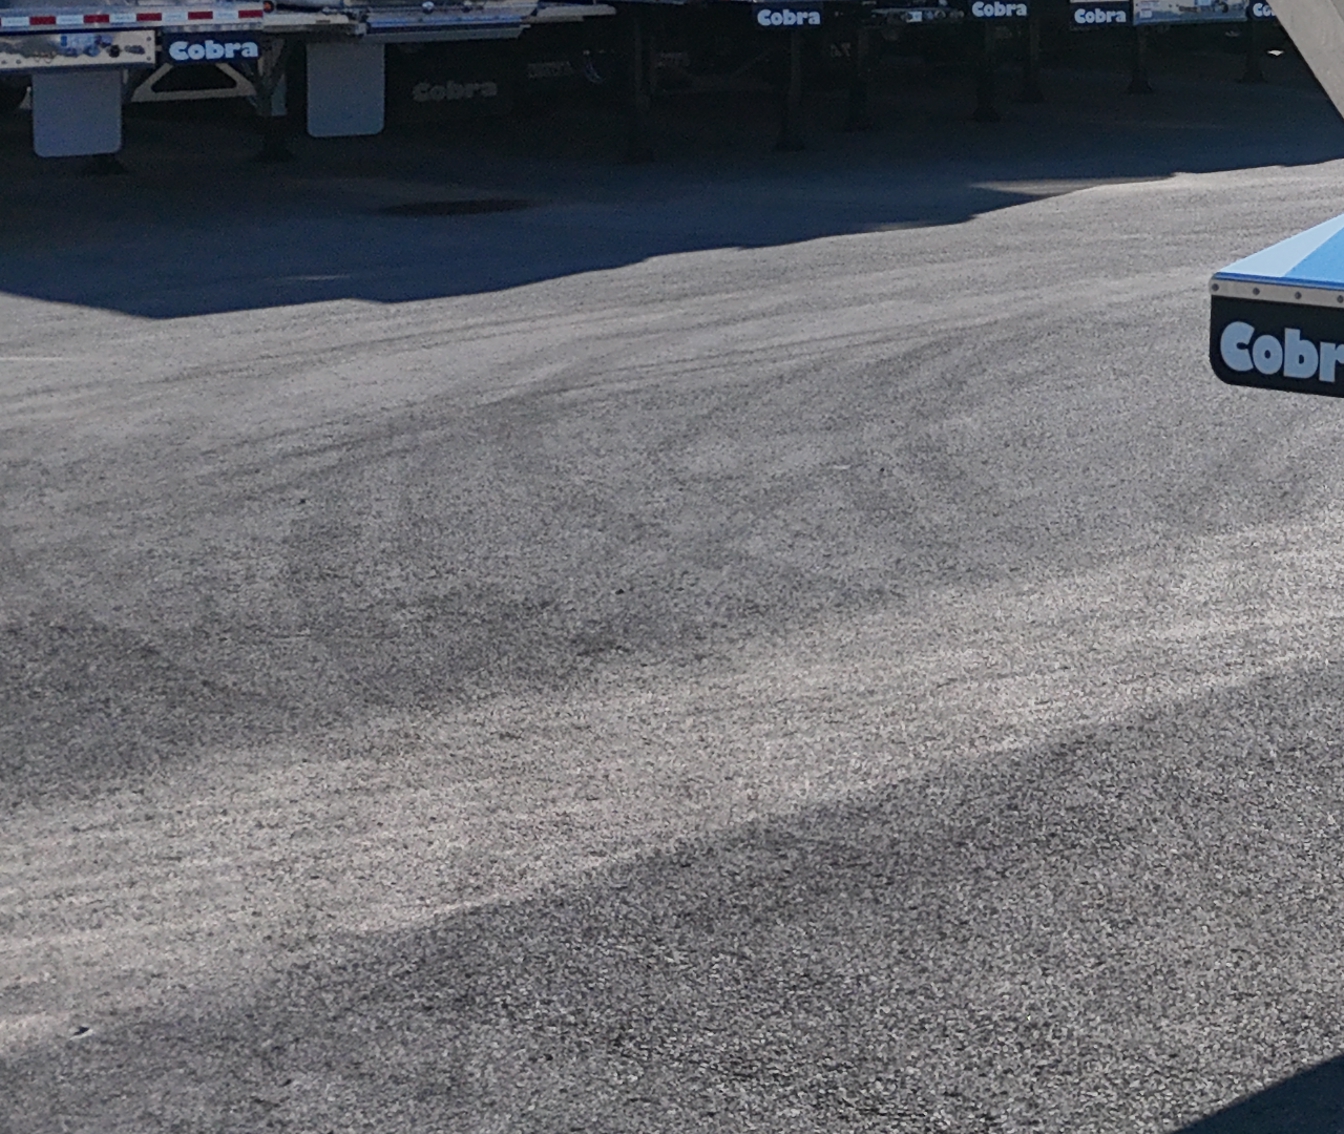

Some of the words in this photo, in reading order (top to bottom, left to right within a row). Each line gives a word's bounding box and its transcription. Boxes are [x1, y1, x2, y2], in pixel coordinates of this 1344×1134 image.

[757, 8, 821, 26] Cobra
[971, 0, 1028, 18] Cobra
[1074, 7, 1127, 24] Cobra
[168, 39, 259, 61] Cobra
[412, 79, 498, 102] Cobra
